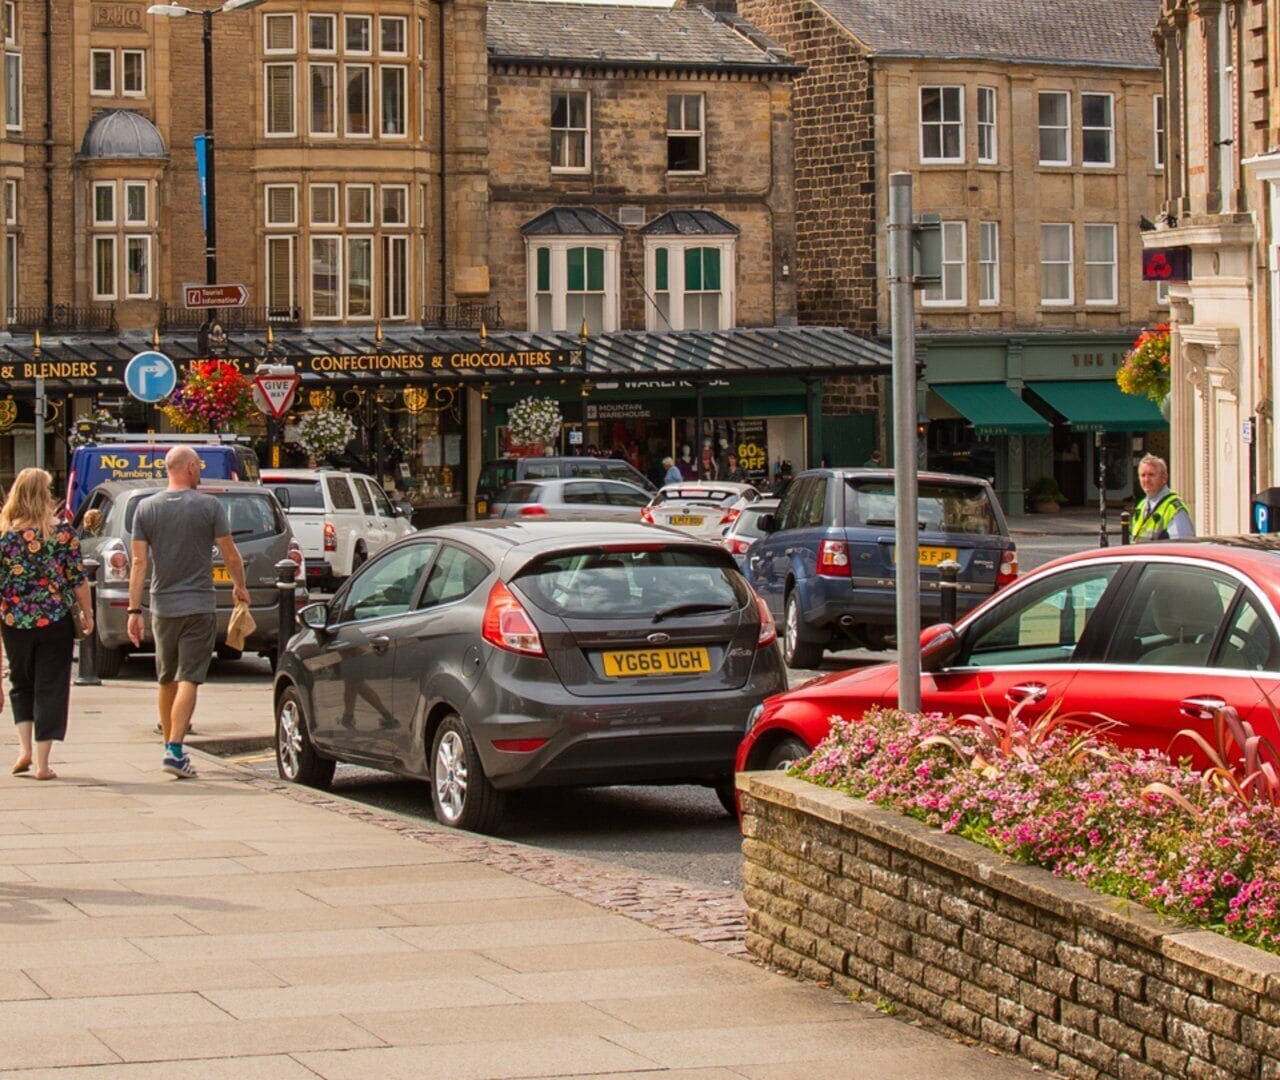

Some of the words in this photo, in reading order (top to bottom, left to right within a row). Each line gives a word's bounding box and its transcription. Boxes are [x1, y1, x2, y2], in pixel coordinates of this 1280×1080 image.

[202, 296, 238, 304] Information
[311, 354, 425, 371] CONFECTIONERS
[431, 356, 444, 368] &
[451, 351, 552, 368] CHOCOLATIERS
[1, 366, 15, 379] &
[24, 362, 98, 378] BLENDERS
[264, 381, 289, 390] GIVE
[599, 410, 651, 418] WAREHOUSE
[100, 455, 129, 469] No
[112, 470, 153, 480] Plumbing
[613, 653, 663, 672] YG66
[666, 651, 703, 669] UGH
